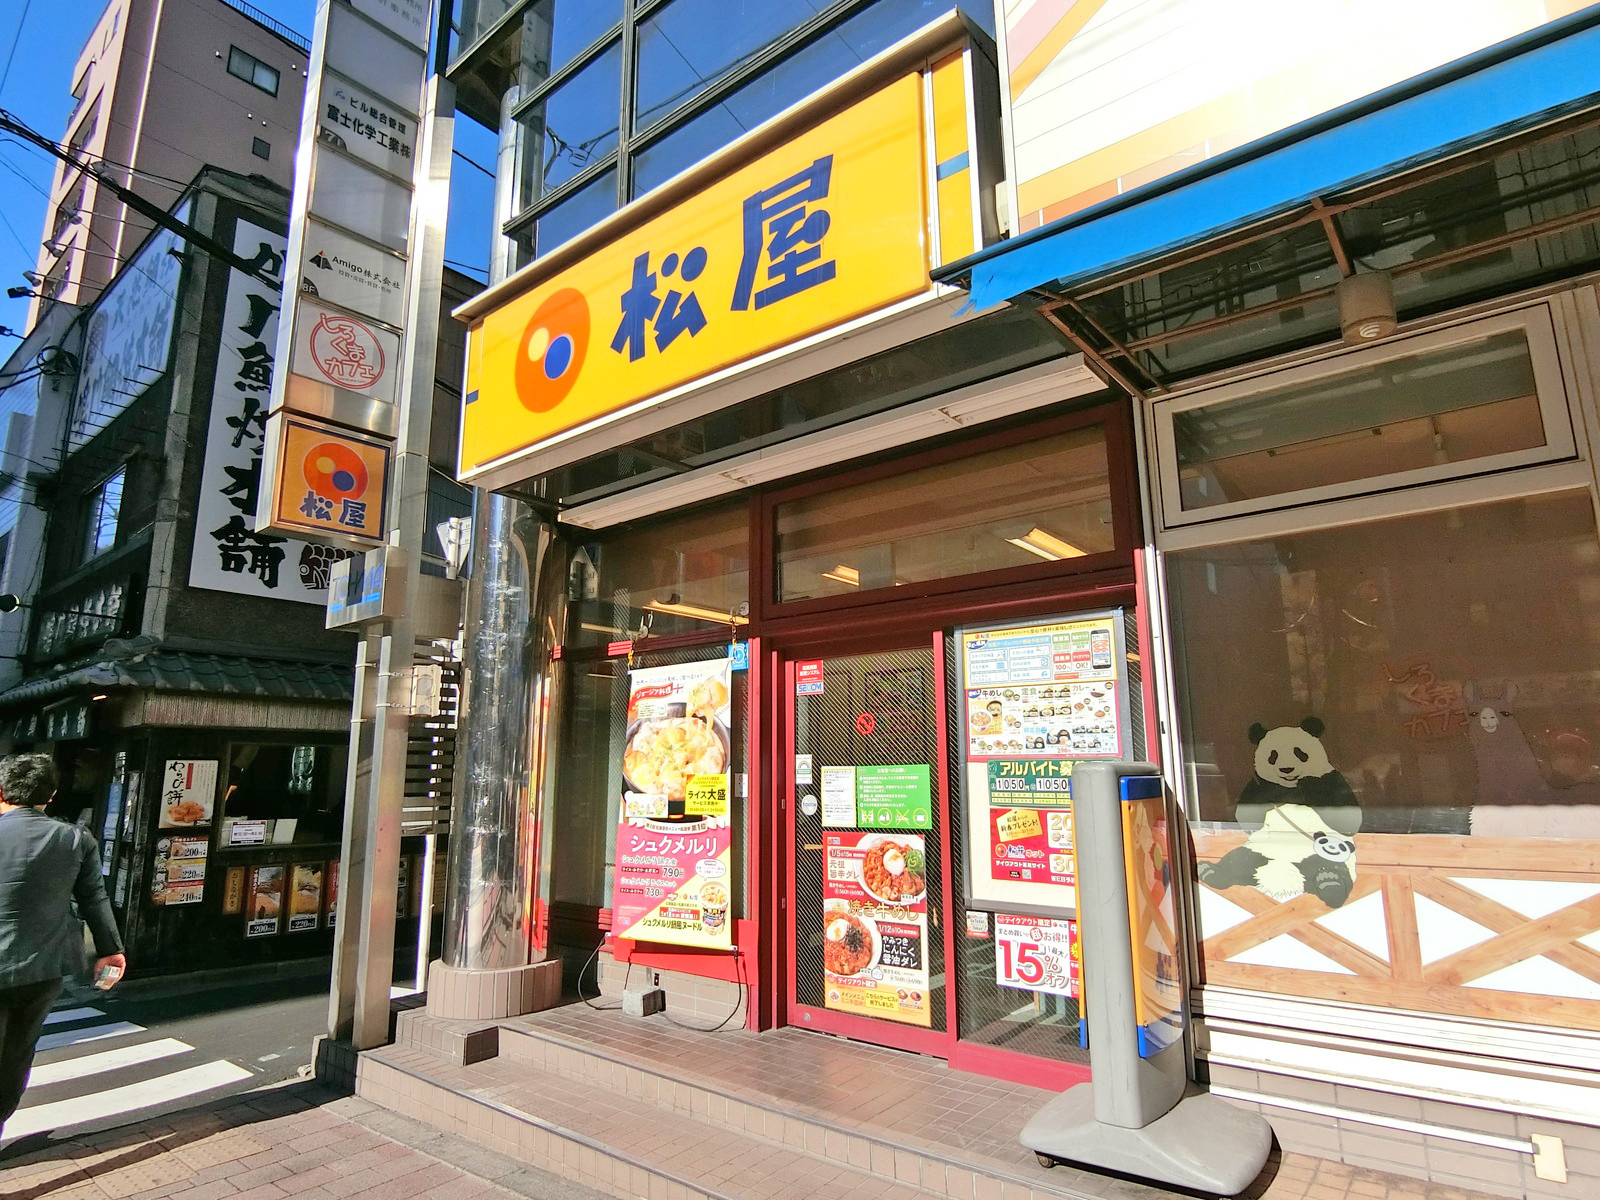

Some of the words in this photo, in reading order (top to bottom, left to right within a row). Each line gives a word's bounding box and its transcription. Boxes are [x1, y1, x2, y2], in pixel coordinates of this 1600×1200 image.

[350, 96, 407, 134] ビル総合管理
[609, 154, 836, 363] 松屋
[299, 490, 366, 529] 松屋
[798, 683, 822, 692] SECOM
[999, 761, 1084, 777] アルバイト募
[1037, 779, 1067, 790] 1050
[688, 789, 726, 801] ライス大盛
[630, 834, 717, 857] シュクメルリ
[830, 859, 845, 868] 元祖
[830, 869, 859, 880] 旨辛ダレ
[848, 898, 920, 922] 焼き牛めし
[643, 917, 703, 931] シュクメルリ鍋風ヌードル
[1004, 916, 1052, 927] テイクアウト限定
[883, 935, 909, 946] やみつき
[883, 944, 916, 957] にんにく
[883, 953, 918, 968] 醤油ダレ
